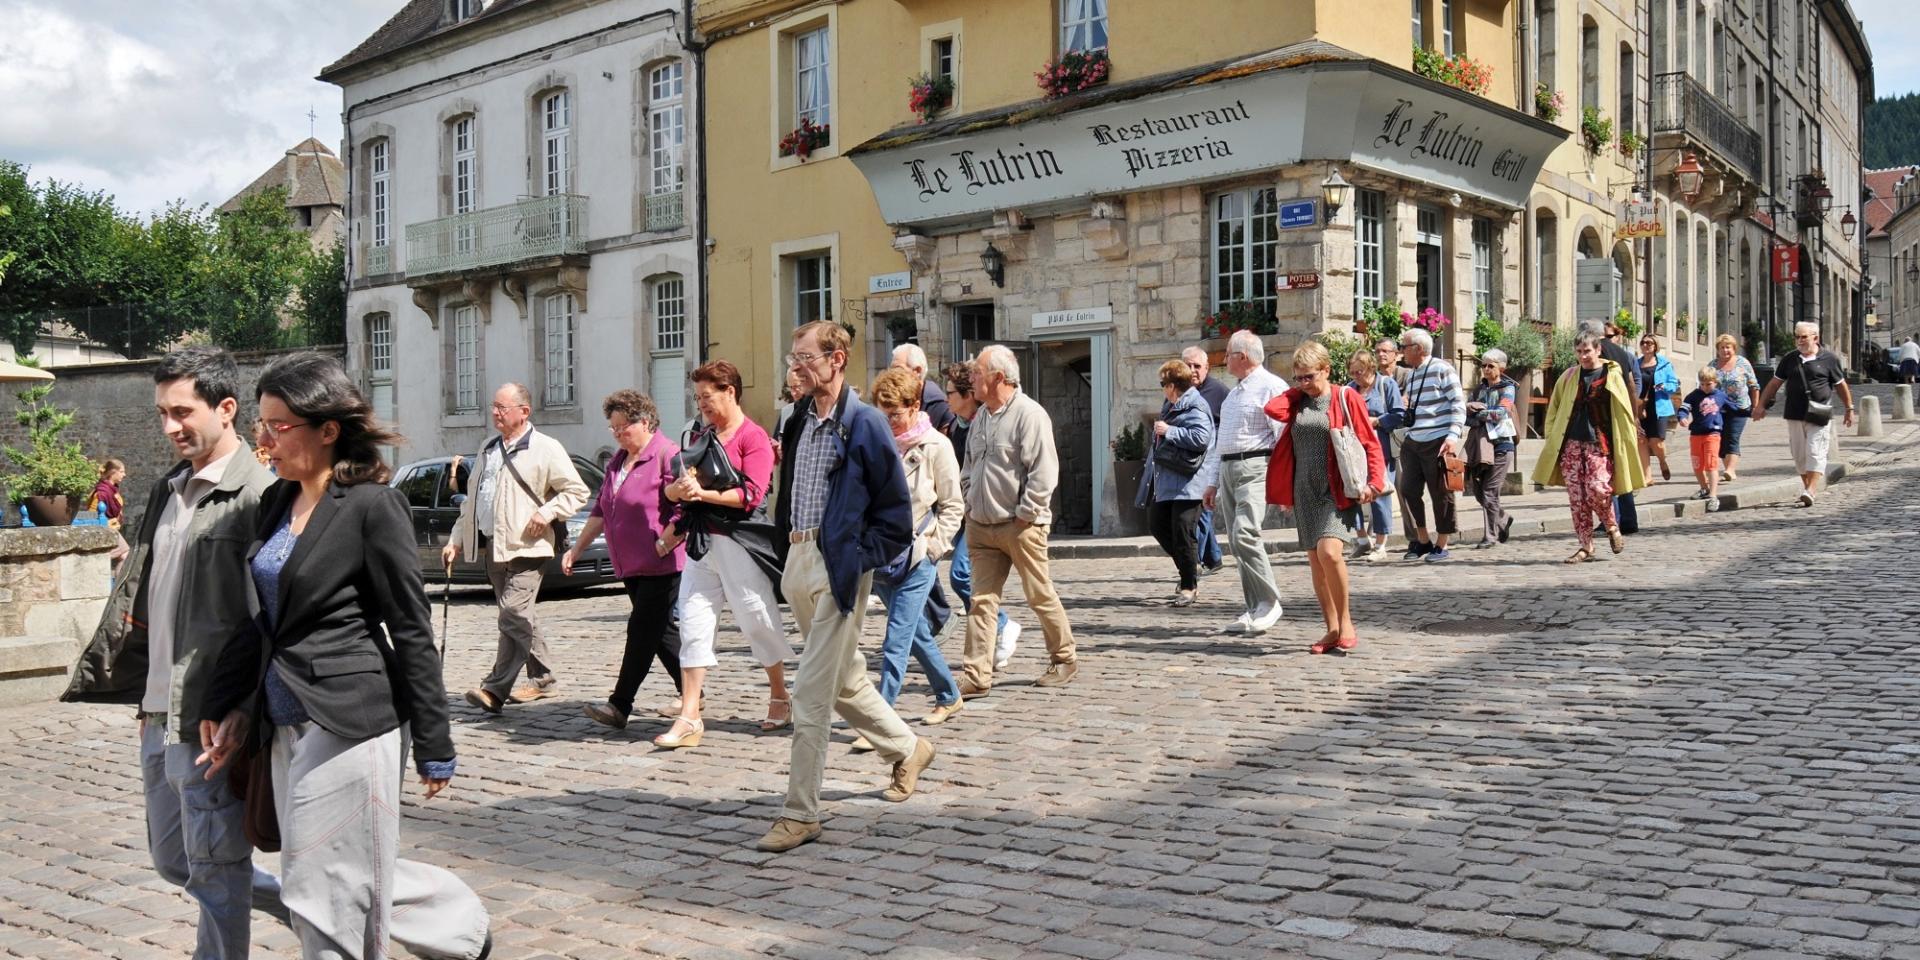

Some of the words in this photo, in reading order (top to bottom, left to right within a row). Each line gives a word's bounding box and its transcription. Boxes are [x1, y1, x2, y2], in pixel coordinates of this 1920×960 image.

[1087, 99, 1250, 147] Restaurant
[1373, 98, 1413, 149] Le
[1410, 110, 1484, 168] Lutrin
[903, 158, 952, 203] Le
[950, 142, 1063, 196] Lutrin
[1122, 136, 1233, 178] Pizzeria
[1492, 148, 1527, 183] Grill
